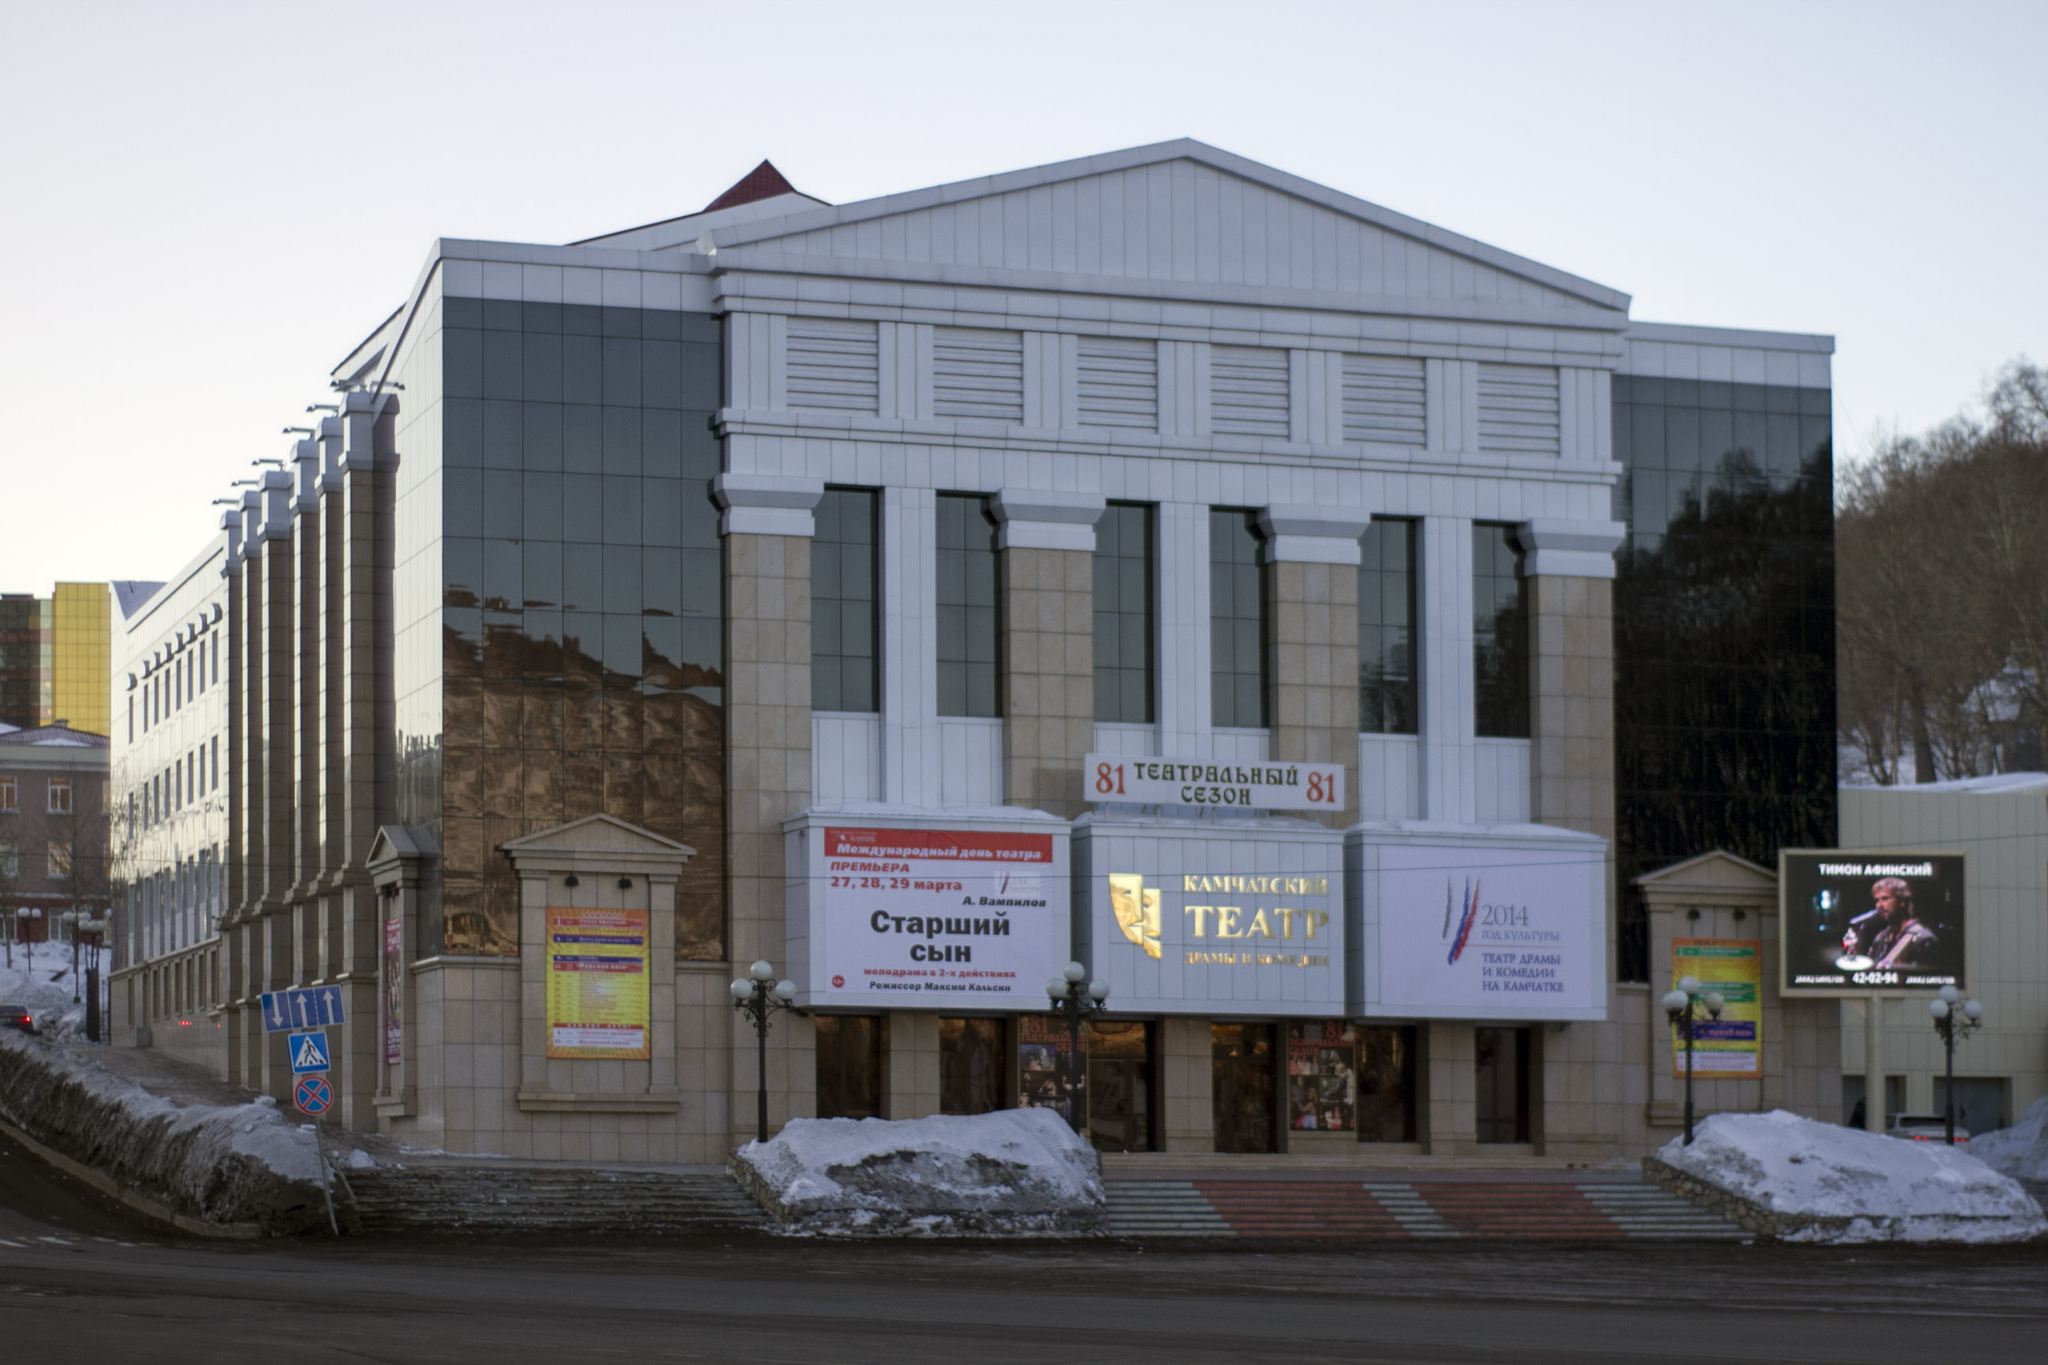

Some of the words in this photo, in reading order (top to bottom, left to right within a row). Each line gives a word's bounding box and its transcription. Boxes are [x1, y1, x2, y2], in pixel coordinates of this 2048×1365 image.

[1095, 762, 1125, 794] 81
[1134, 762, 1298, 786] ТЕАТРАЛЬНЫЙ
[1306, 772, 1335, 803] 81
[1181, 786, 1251, 805] СЕЗОН
[836, 843, 957, 859] Международный
[959, 849, 993, 859] день
[996, 850, 1042, 860] театра
[830, 861, 910, 873] ПРЕМЬЕРА
[1819, 864, 1862, 876] ТИМОН
[1864, 862, 1933, 876] АФИНСКИЙ
[831, 876, 856, 890] 27,
[860, 877, 885, 891] 28,
[890, 878, 910, 890] 29
[914, 881, 962, 893] марта
[1183, 875, 1328, 895] КАМЧАТСКИЙ
[962, 896, 976, 906] А.
[979, 896, 1046, 908] Вампилов
[1184, 906, 1329, 939] ТЕАТР
[1481, 905, 1528, 925] 2014
[870, 910, 1010, 939] Старший
[1482, 930, 1502, 941] ГОД
[1505, 931, 1560, 942] КУЛЬТУРЫ
[910, 943, 971, 963] сын
[1183, 951, 1236, 964] ДРАМЫ
[1242, 953, 1251, 964] И
[1257, 953, 1329, 967] КОМЕДИИ
[1482, 953, 1515, 965] ТЕАТР
[1520, 954, 1561, 965] ДРАМЫ
[863, 967, 927, 978] мелодрама
[939, 969, 956, 978] 2-х
[958, 969, 1017, 980] действиях
[1483, 967, 1491, 977] И
[1496, 967, 1554, 979] КОМЕДИИ
[1852, 972, 1898, 983] 42-02-94
[869, 981, 922, 992] Режиссер
[924, 982, 966, 992] Максим
[968, 982, 1011, 992] Кальсин
[1482, 981, 1499, 991] НА
[1503, 982, 1564, 992] КАМЧАТКЕ
[1030, 1016, 1047, 1032] 81
[1326, 1021, 1343, 1038] 81
